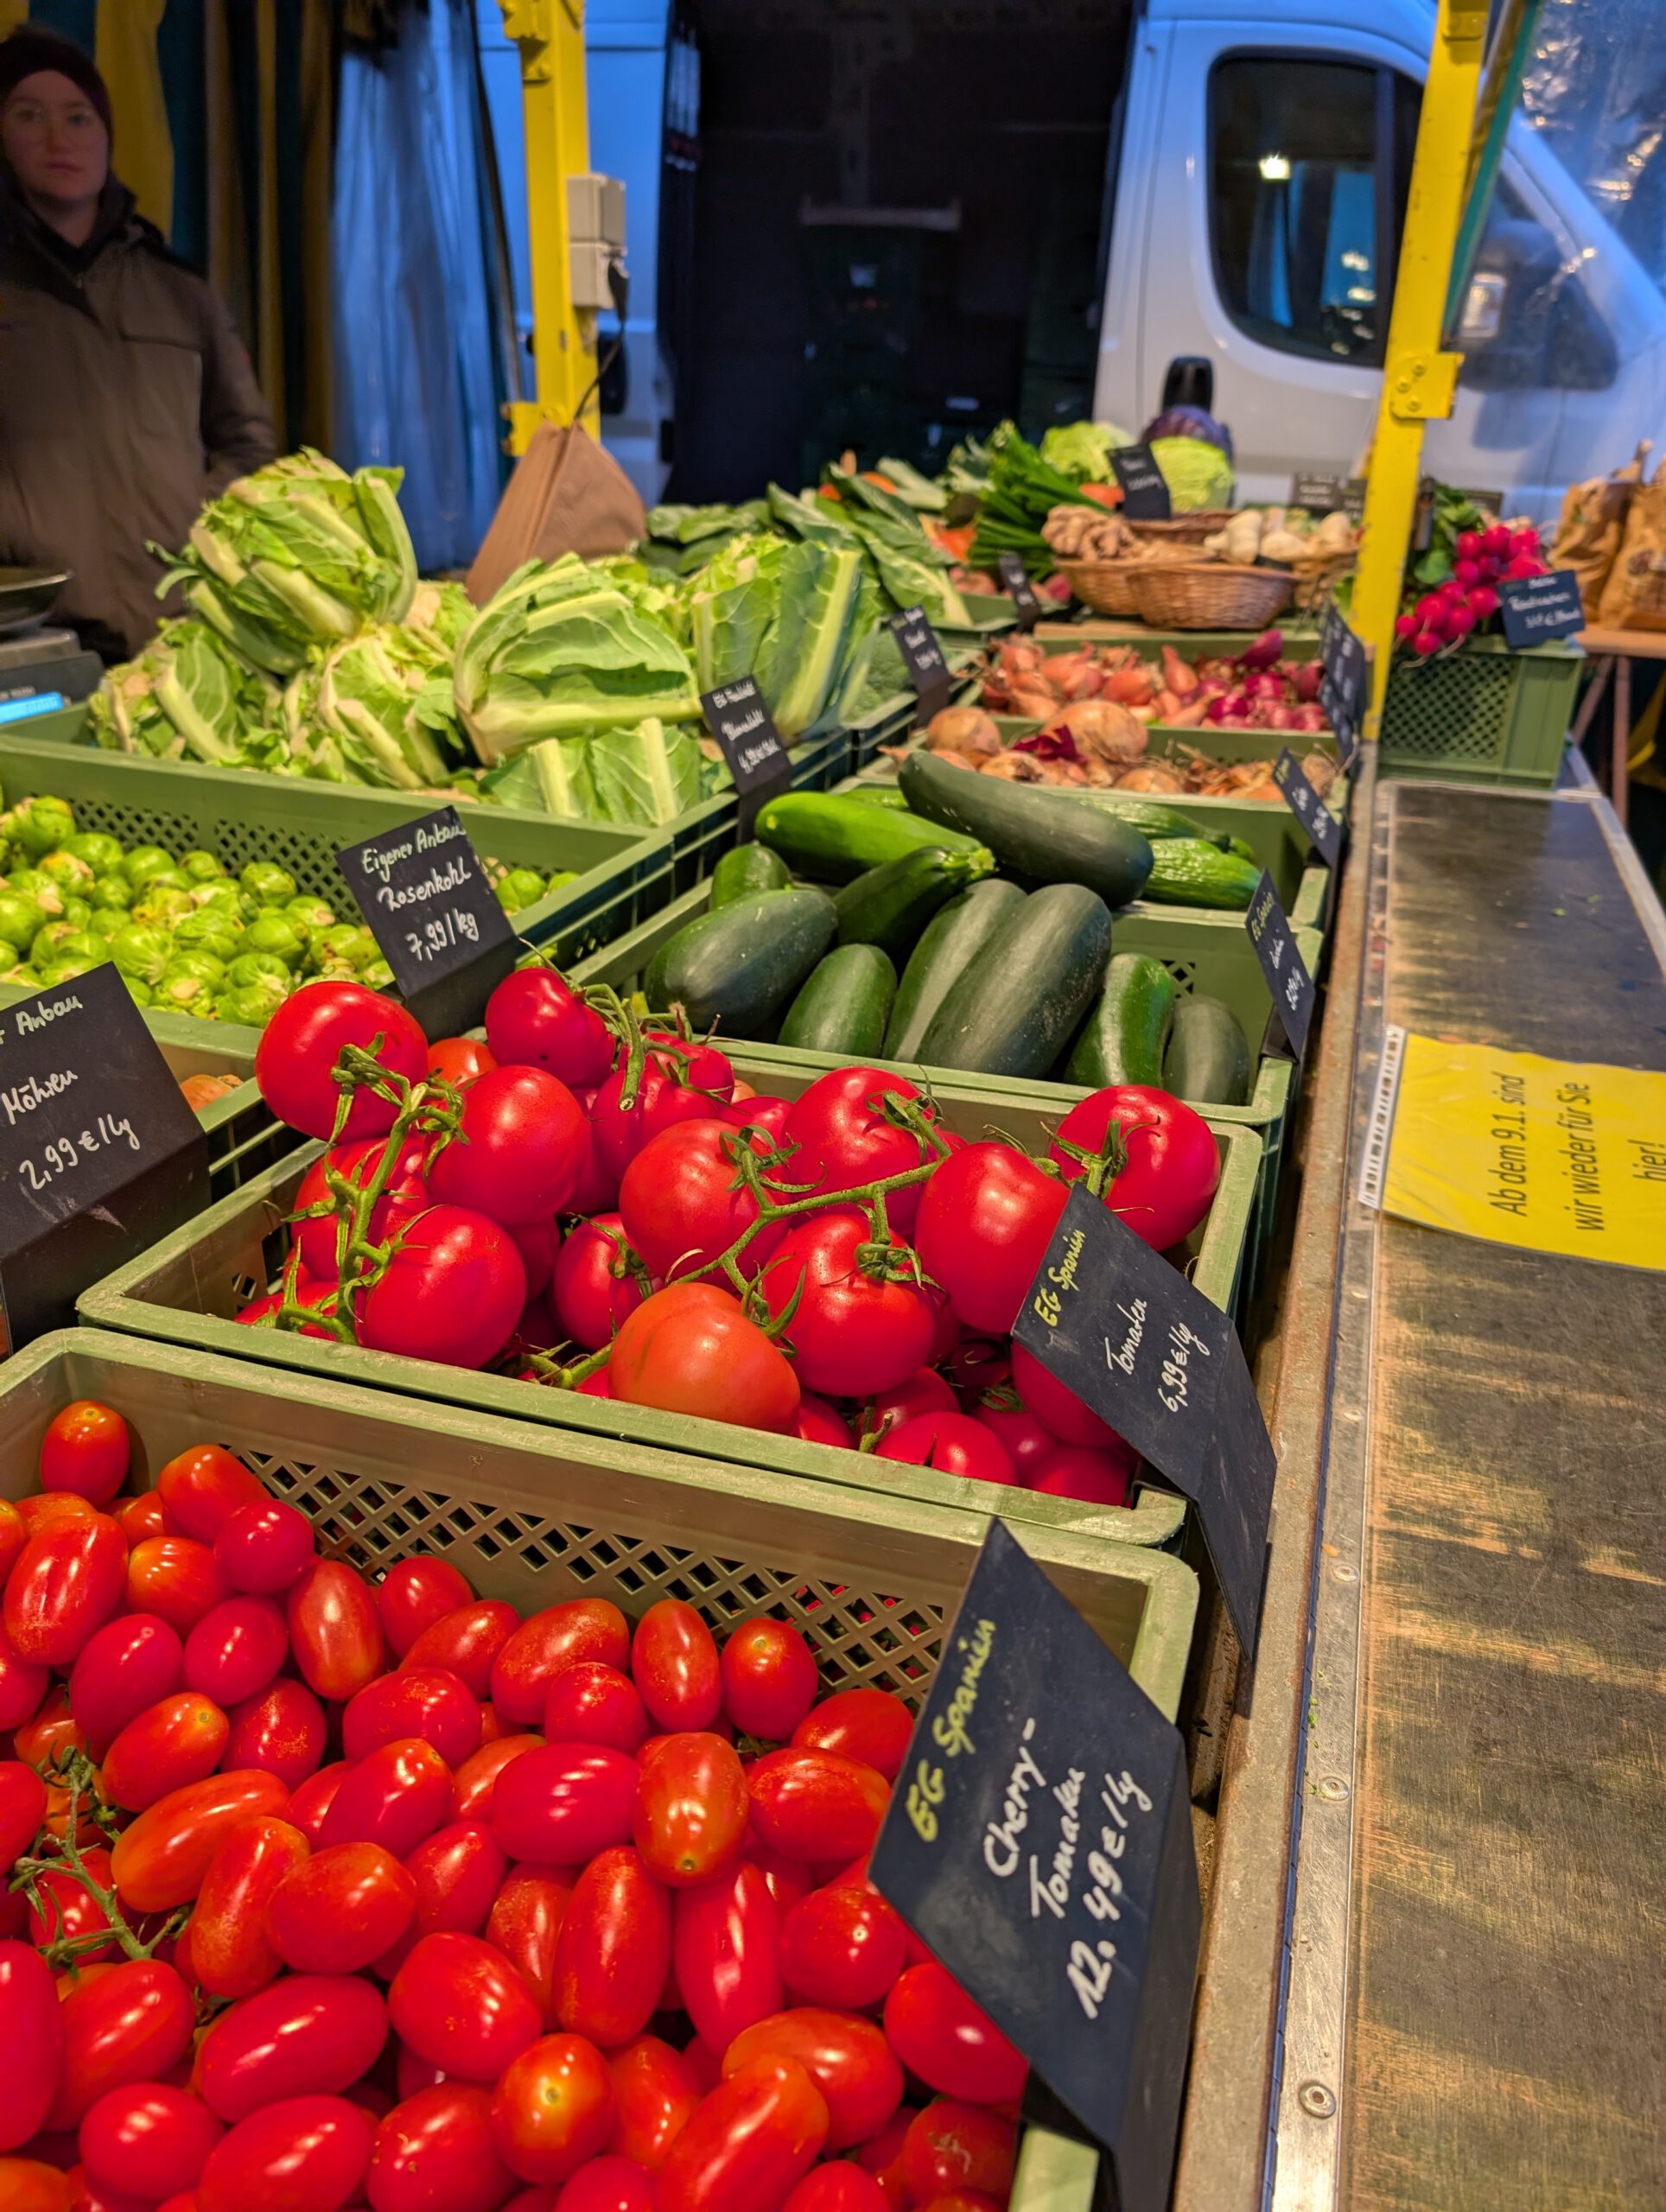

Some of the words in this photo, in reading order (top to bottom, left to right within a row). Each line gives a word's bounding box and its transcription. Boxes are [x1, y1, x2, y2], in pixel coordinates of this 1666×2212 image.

[362, 842, 412, 882] Eigener
[416, 823, 467, 853] Anbau
[377, 855, 471, 911] Rosenkohl
[16, 995, 83, 1035] Anbau
[2, 1070, 79, 1125] Möhren
[1491, 1071, 1526, 1106] sind
[1555, 1082, 1591, 1105] Sie
[1556, 1106, 1594, 1133] für
[1487, 1144, 1527, 1185] dem
[1558, 1134, 1601, 1194] wieder
[1626, 1139, 1666, 1183] hier!
[1487, 1188, 1527, 1217] Ab
[1564, 1198, 1605, 1230] wir
[1047, 1229, 1086, 1292] Spanien
[1033, 1287, 1062, 1327] EG
[1104, 1298, 1148, 1375] Tomaten
[906, 1758, 946, 1842] EG
[932, 1618, 996, 1757] Spanien
[1030, 1767, 1085, 1919] Tomaten
